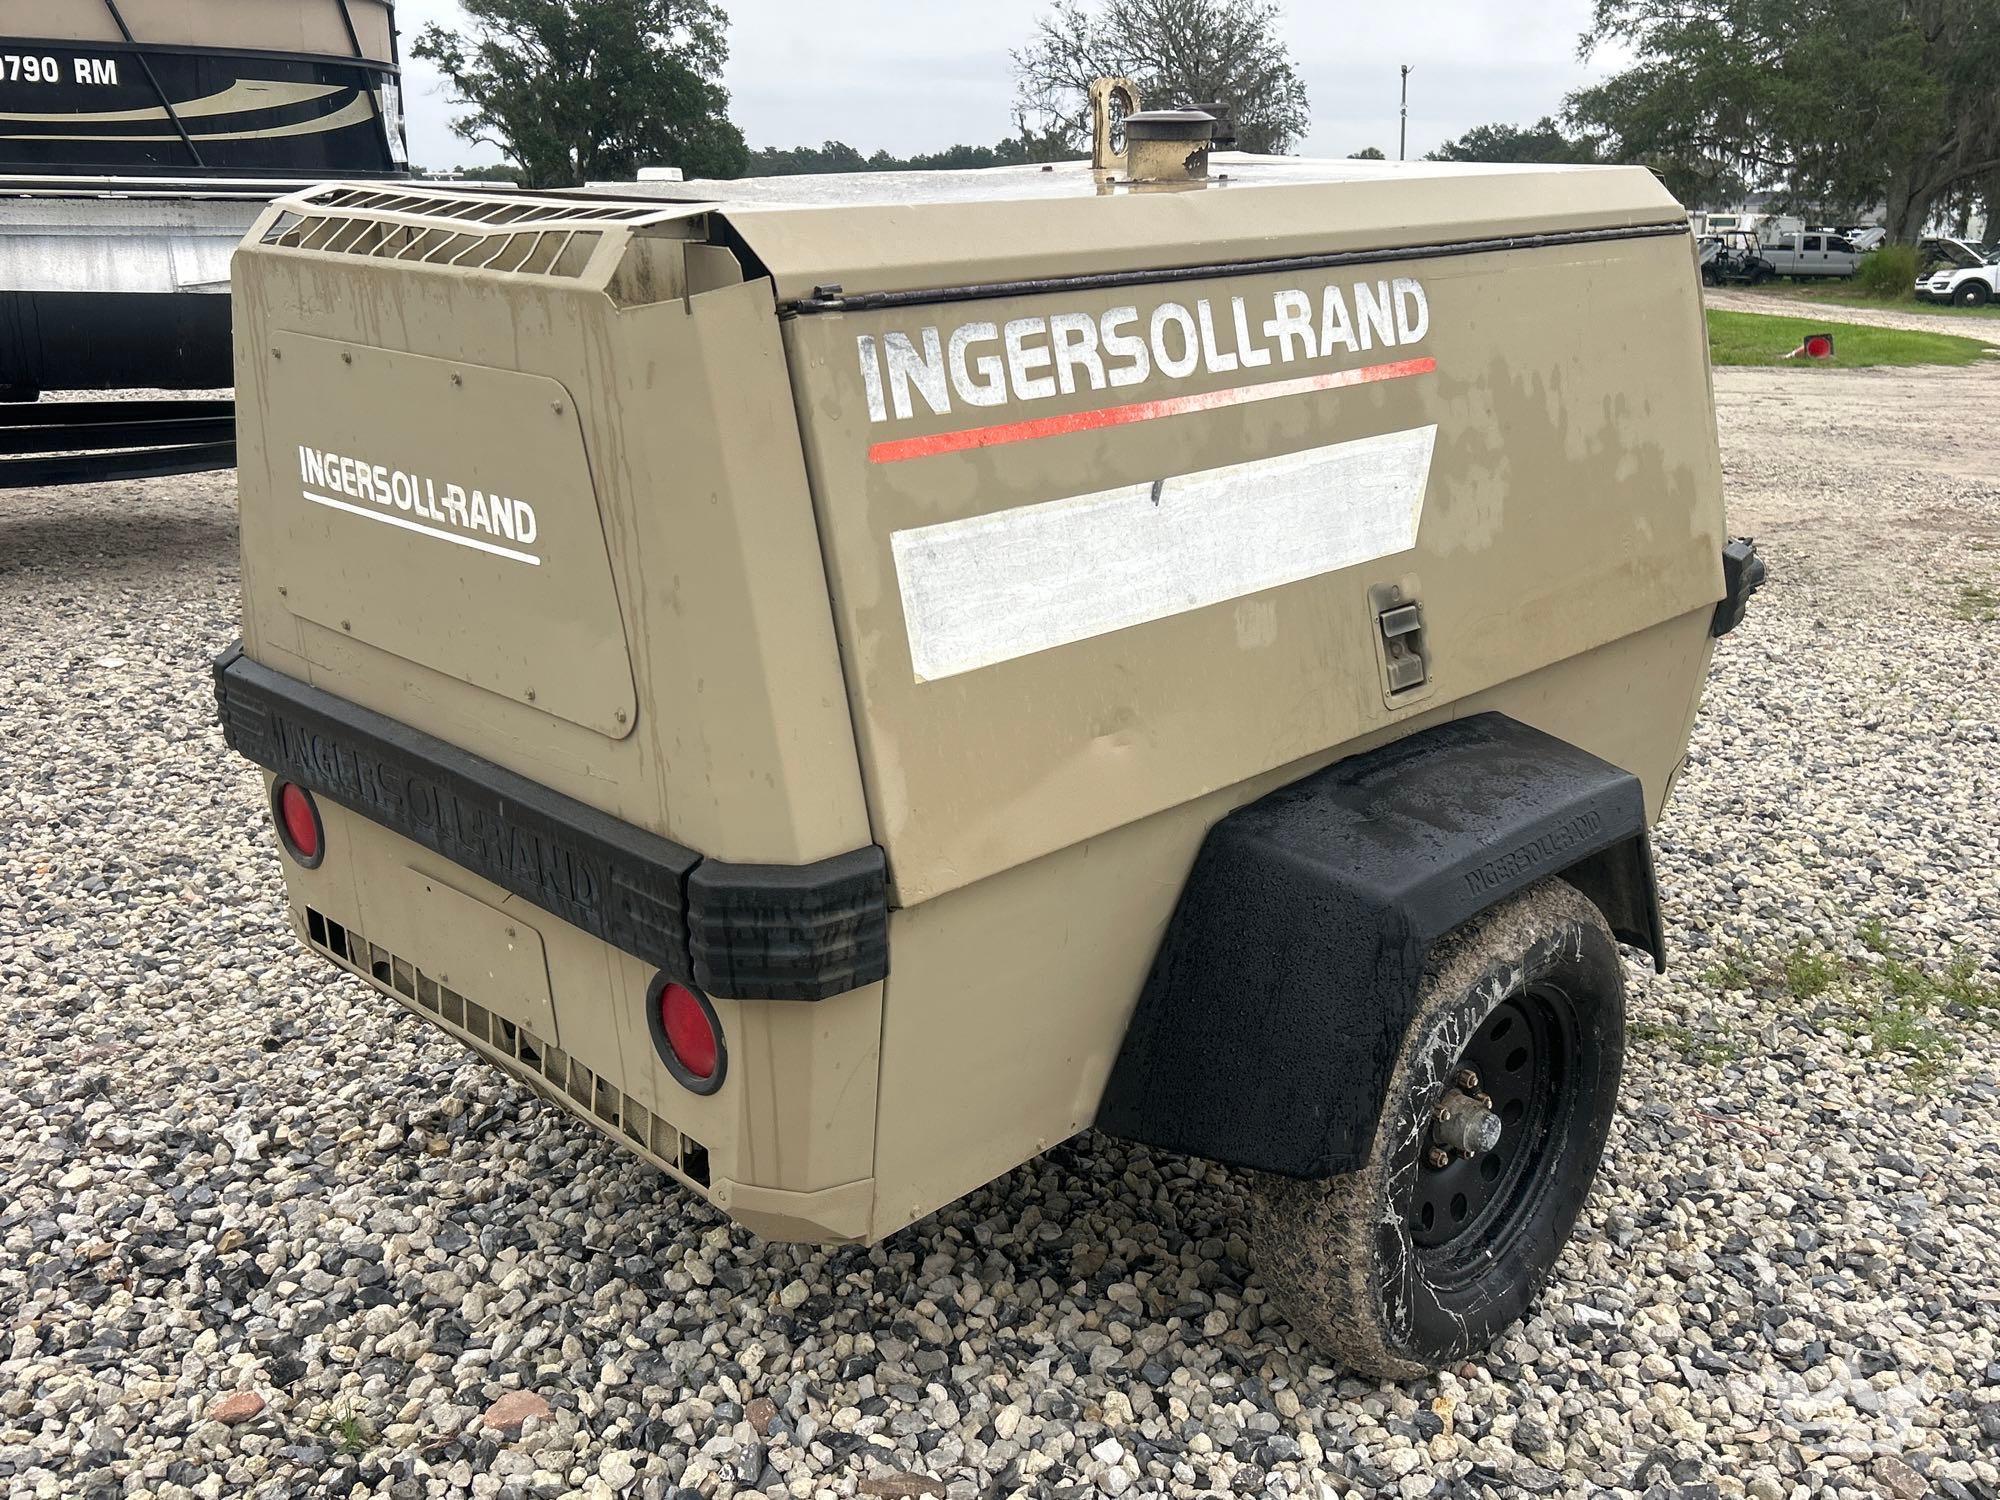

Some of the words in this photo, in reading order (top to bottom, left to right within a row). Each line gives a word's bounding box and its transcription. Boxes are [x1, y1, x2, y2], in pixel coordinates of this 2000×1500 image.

[0, 56, 59, 82] 790
[74, 58, 118, 85] RM
[857, 278, 1430, 421] INGERSOLL-RAND
[299, 445, 537, 544] INGERSOLL-RAND
